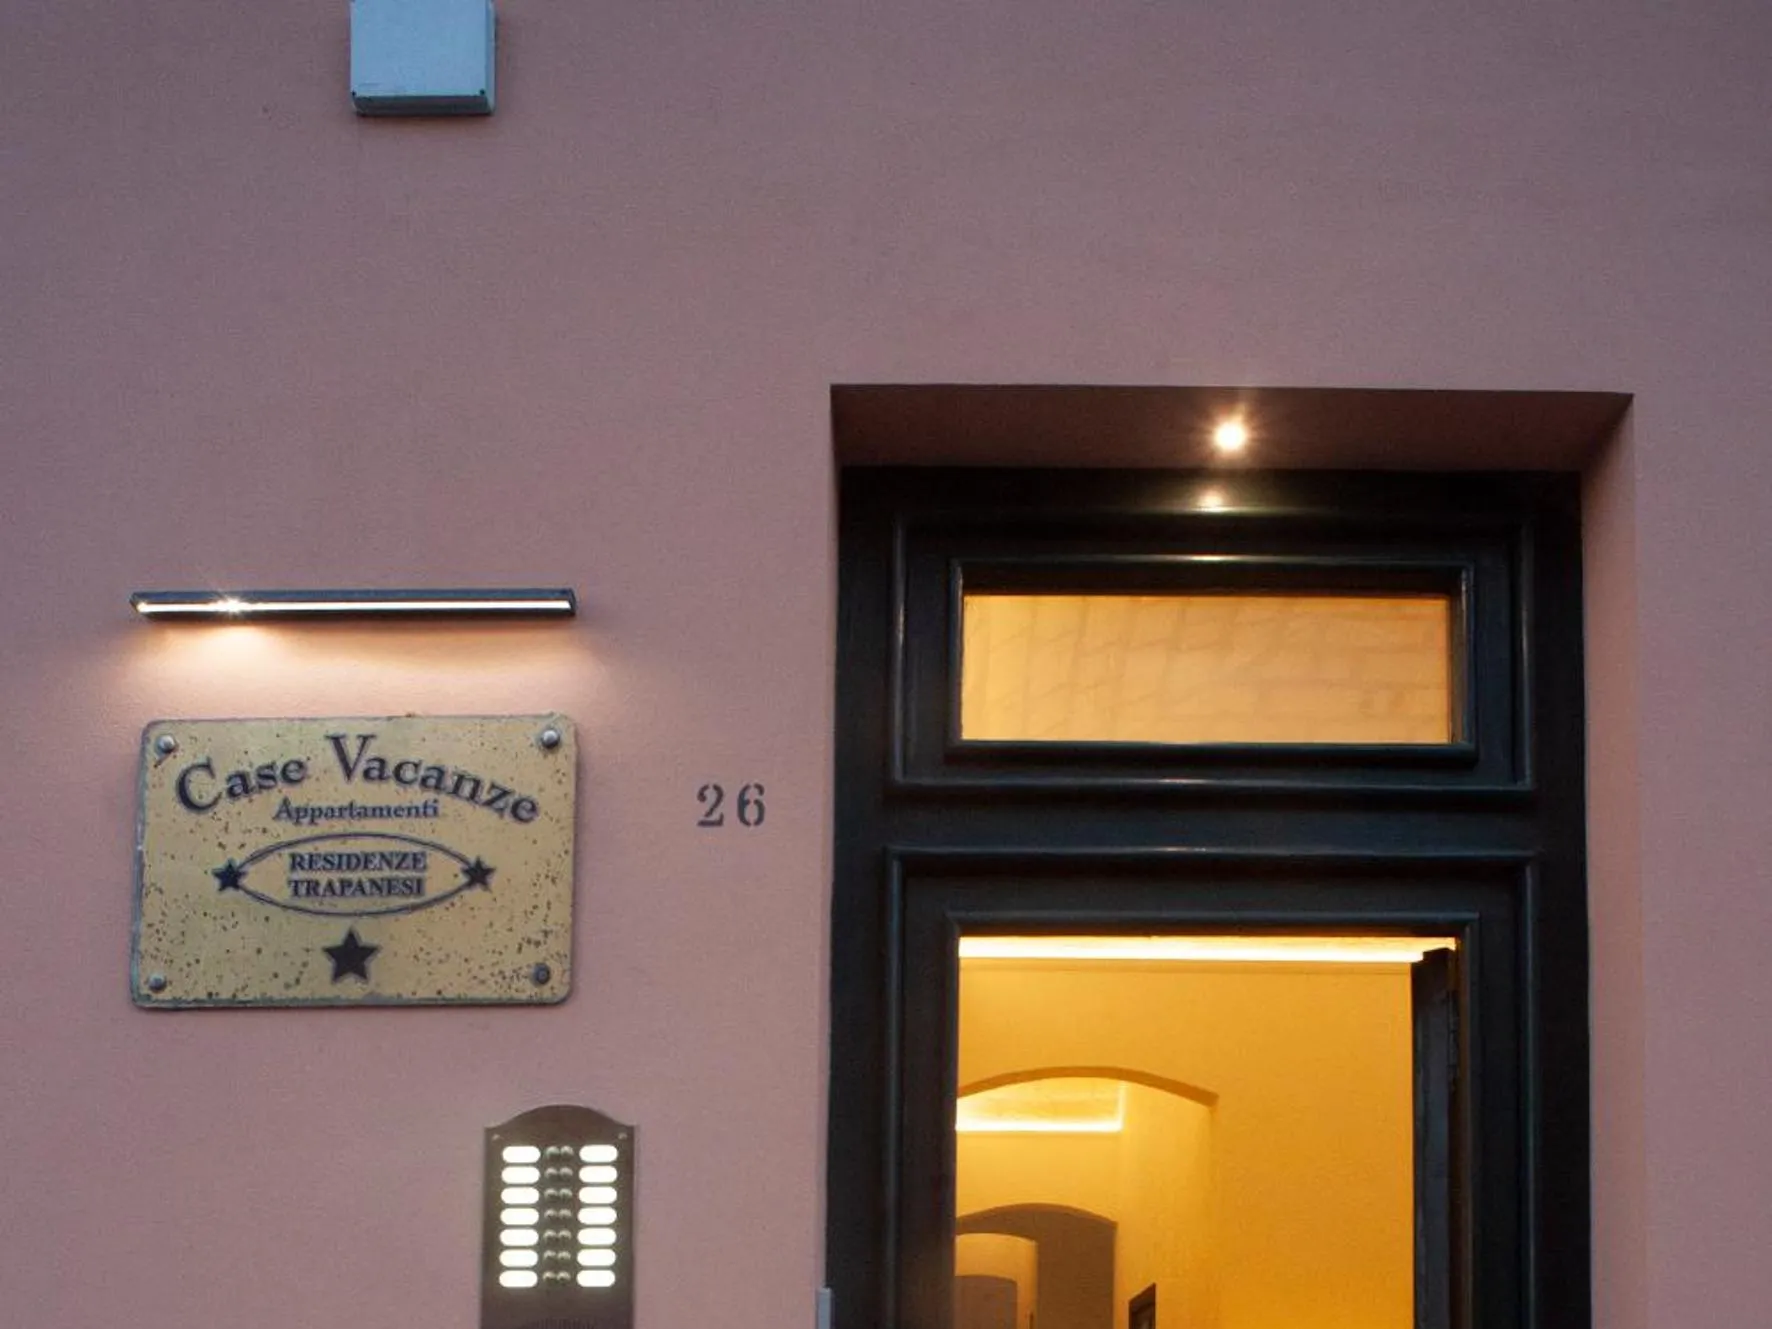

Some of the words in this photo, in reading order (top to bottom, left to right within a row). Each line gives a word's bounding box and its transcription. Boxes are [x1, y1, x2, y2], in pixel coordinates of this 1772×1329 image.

[175, 757, 307, 814] Case
[325, 734, 539, 824] Vacanze
[273, 798, 440, 826] Appartamenti
[696, 783, 766, 827] 26
[288, 851, 428, 873] RESIDENZE
[287, 877, 425, 898] TRAPANESI
